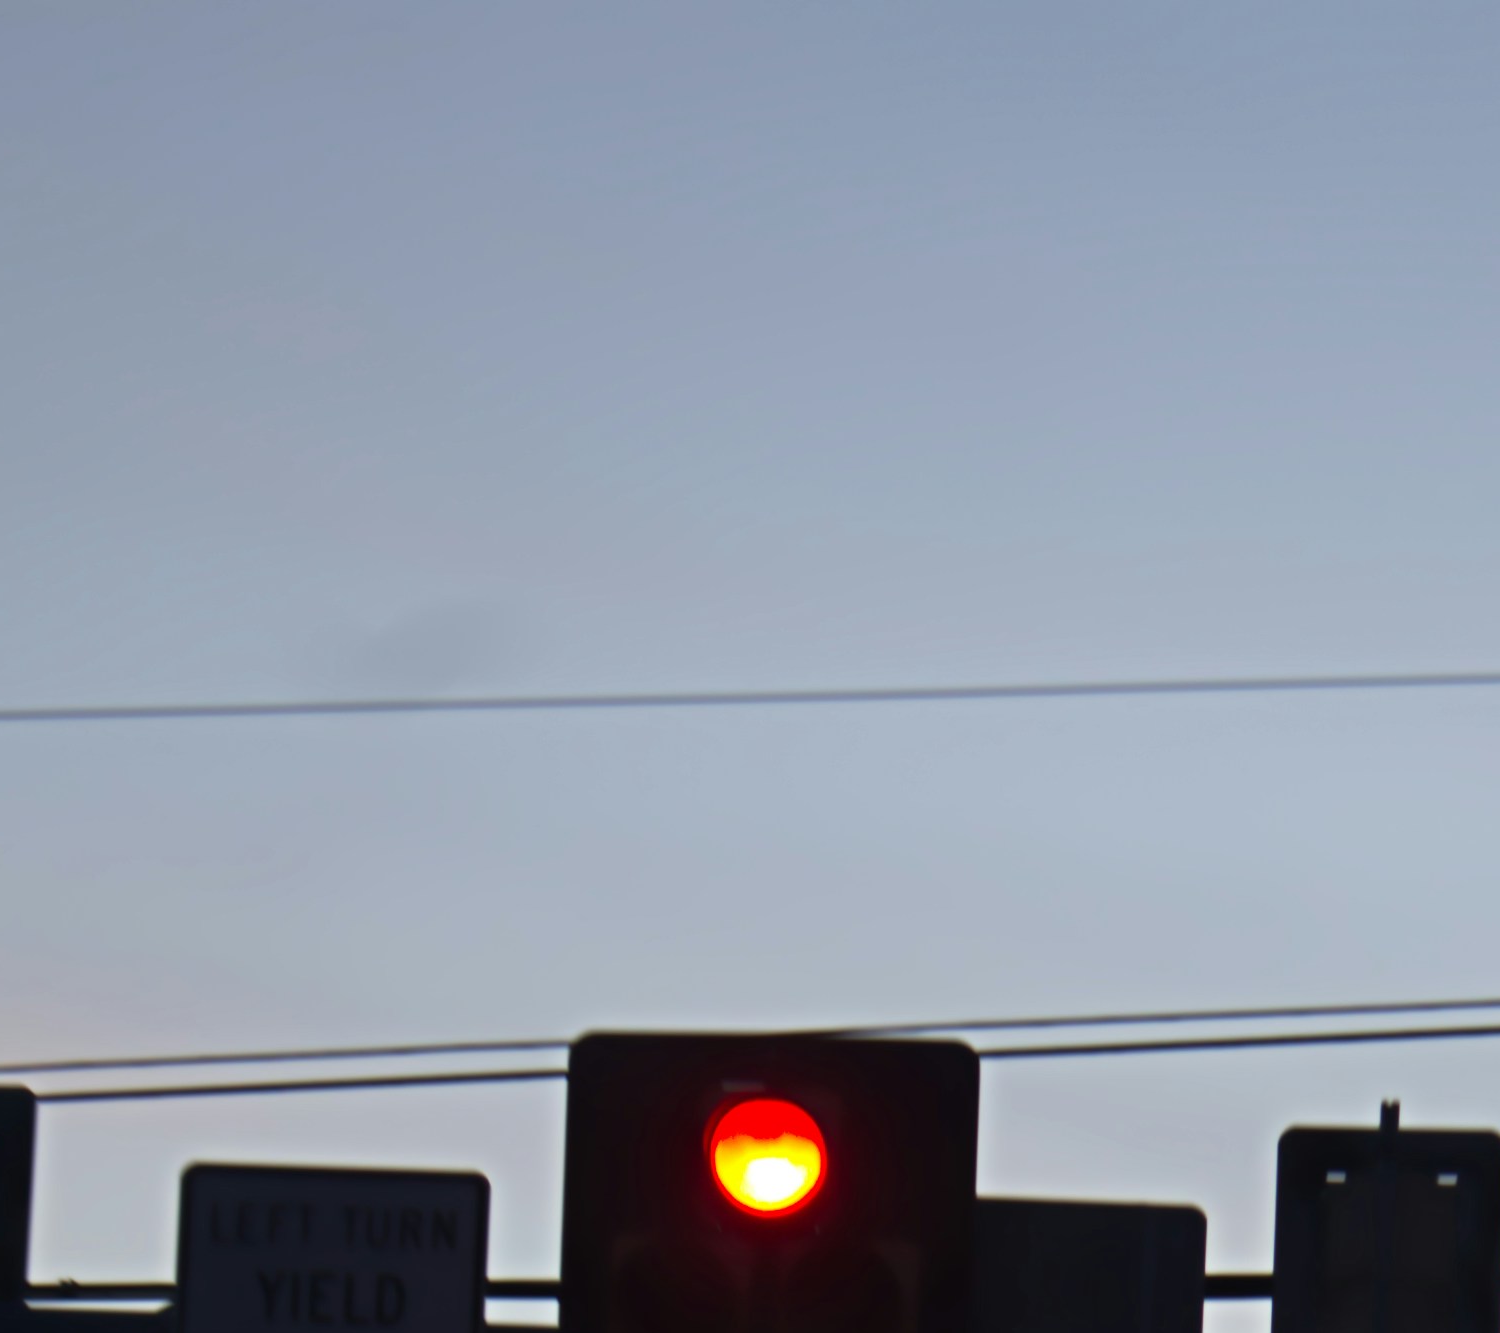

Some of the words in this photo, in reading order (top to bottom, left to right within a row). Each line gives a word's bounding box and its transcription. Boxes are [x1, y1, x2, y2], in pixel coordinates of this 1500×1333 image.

[209, 1202, 313, 1246] LEFT
[344, 1206, 458, 1251] TURN
[257, 1269, 408, 1327] YIELD
